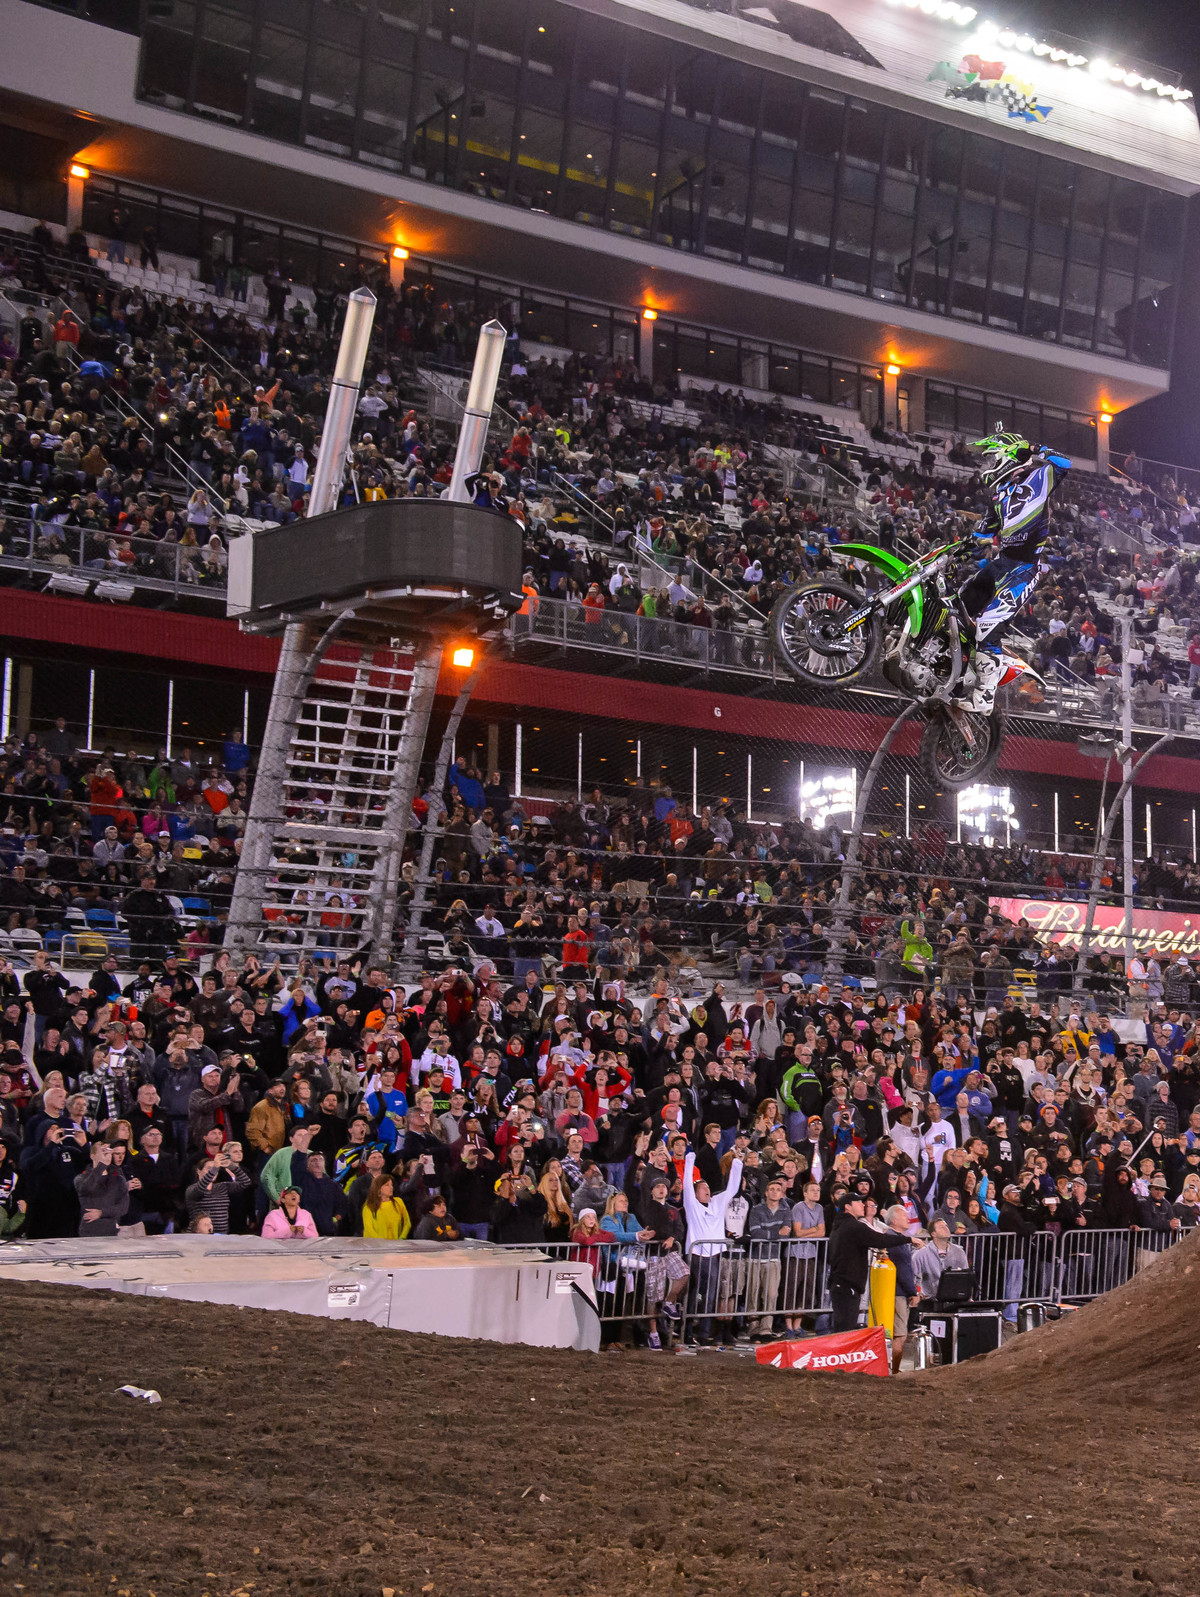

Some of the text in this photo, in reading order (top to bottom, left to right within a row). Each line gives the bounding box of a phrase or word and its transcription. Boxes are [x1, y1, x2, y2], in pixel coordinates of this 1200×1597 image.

[843, 606, 872, 629] DUNLOP
[433, 1102, 450, 1110] ANS
[812, 1349, 879, 1368] HONDA
